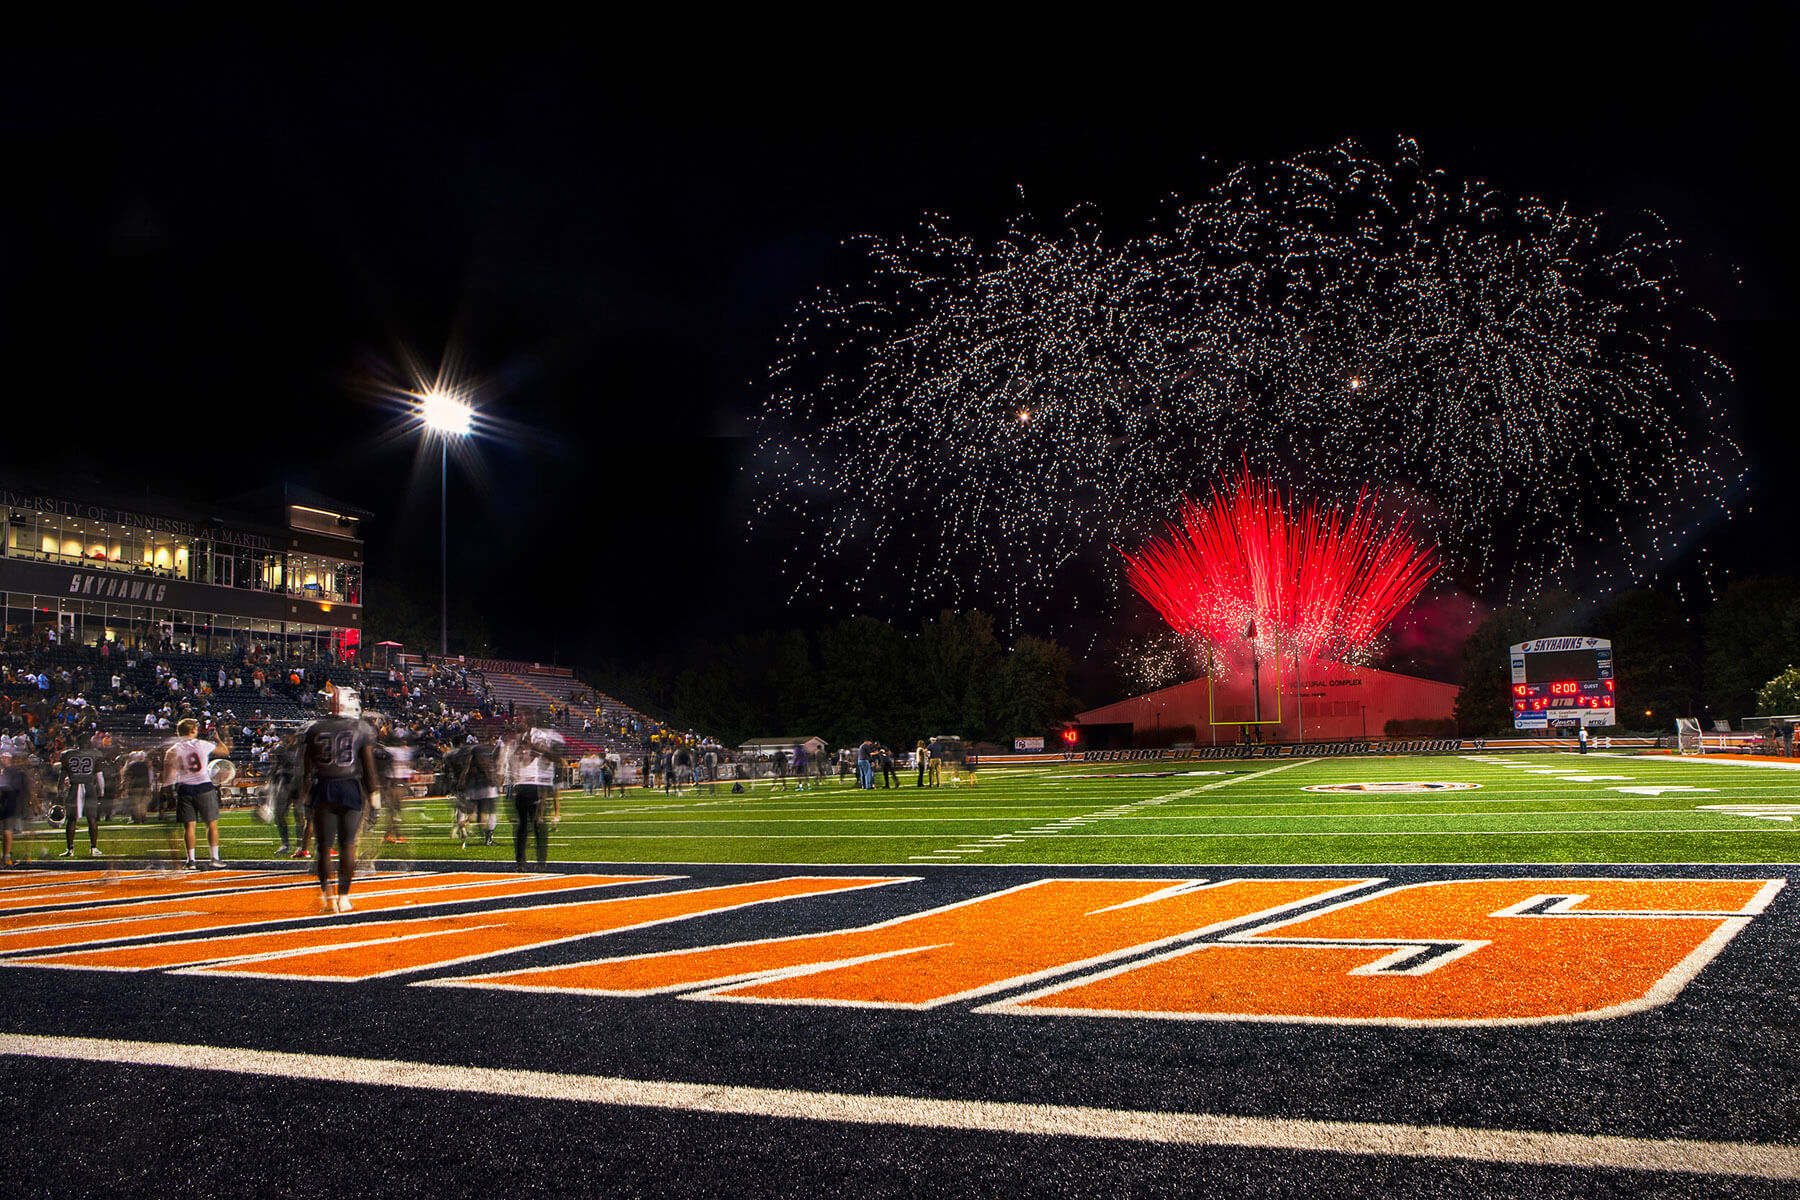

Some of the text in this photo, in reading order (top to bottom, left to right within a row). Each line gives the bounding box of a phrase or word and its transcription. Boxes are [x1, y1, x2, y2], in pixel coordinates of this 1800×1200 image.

[88, 506, 108, 521] OF
[115, 510, 196, 536] TENNESSEE
[221, 530, 271, 549] MARTIN
[69, 574, 167, 602] SKYHAWKS
[1534, 638, 1583, 651] SKYHAWKS
[1328, 679, 1362, 687] COMPLEX
[1605, 681, 1613, 690] 7
[1064, 731, 1077, 742] 40
[1083, 750, 1165, 762] WELCOME
[1290, 743, 1370, 755] GRAHAM
[1377, 739, 1462, 752] STADIUM
[69, 756, 93, 776] 22
